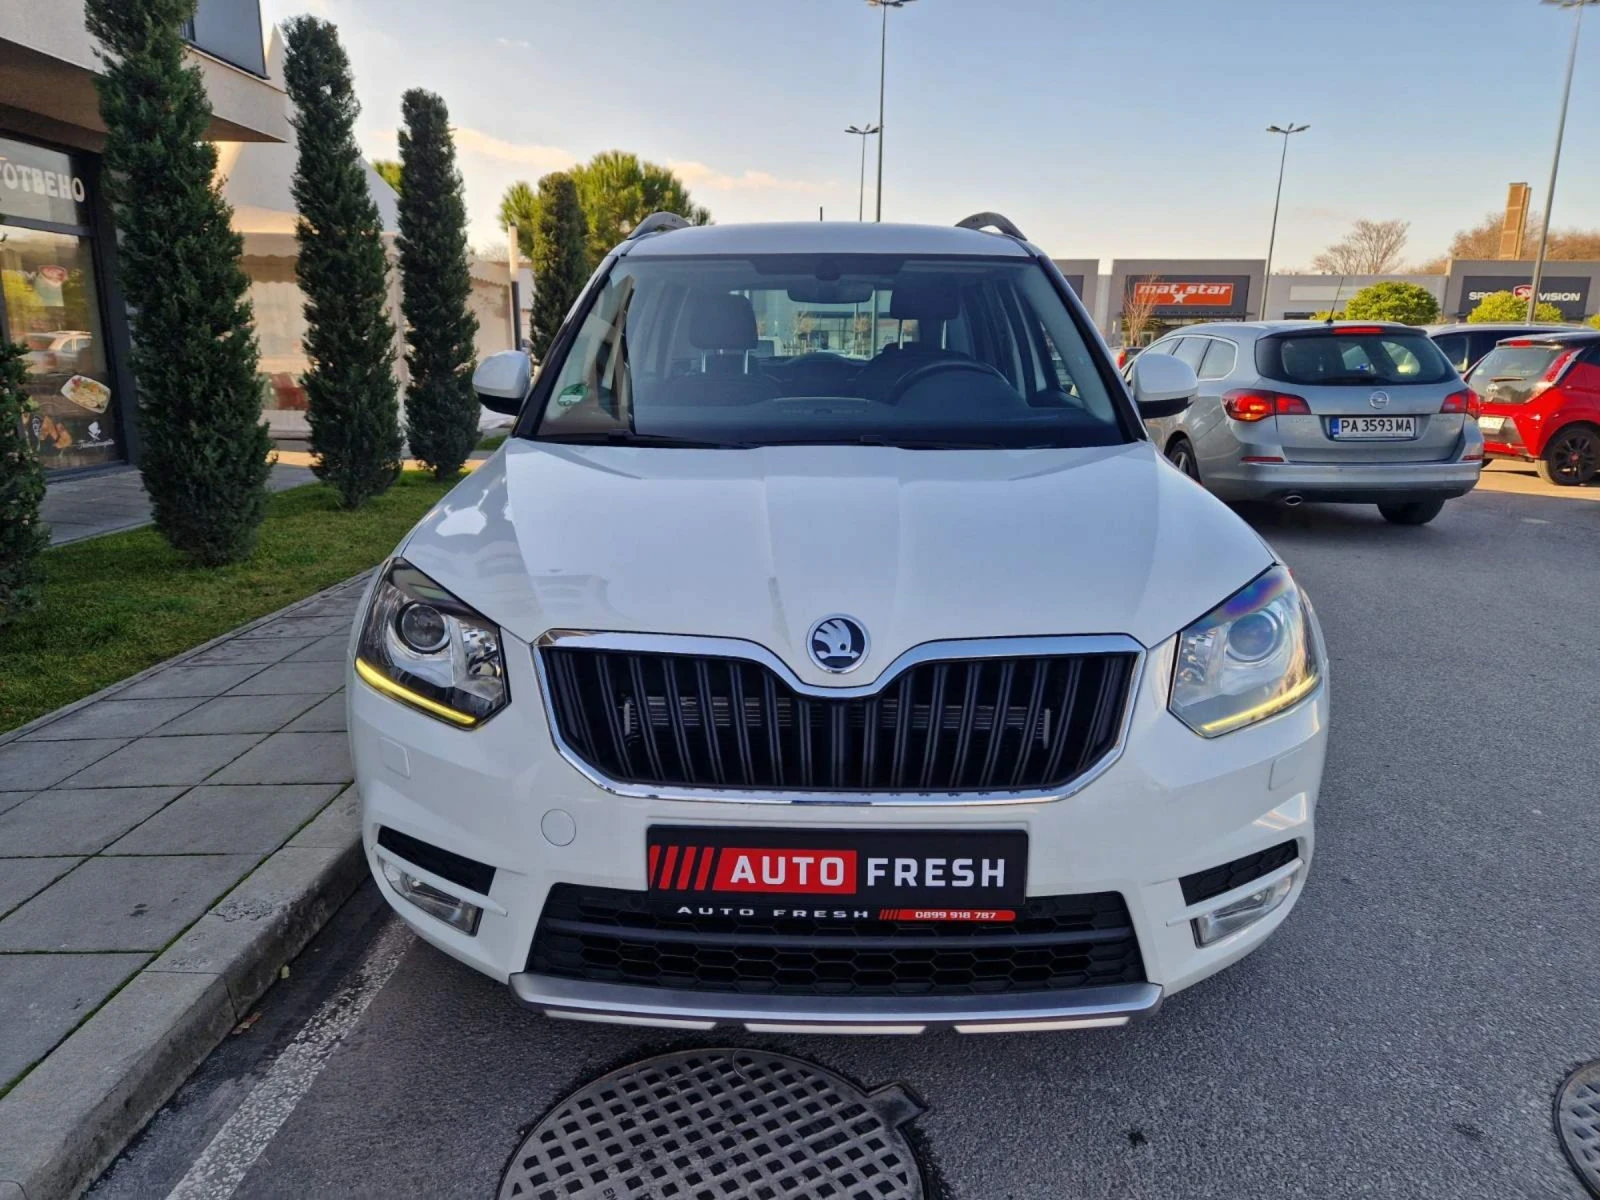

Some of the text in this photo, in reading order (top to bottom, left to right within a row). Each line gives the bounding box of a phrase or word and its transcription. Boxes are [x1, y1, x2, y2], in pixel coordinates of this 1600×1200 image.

[0, 162, 85, 203] ОТВЕНО
[1138, 283, 1231, 294] mat star
[1539, 292, 1581, 302] VISION
[1340, 418, 1412, 433] PA 3593 MA
[729, 855, 1006, 888] AUTO FRESH
[677, 906, 869, 919] AUTO FRESH
[914, 910, 997, 920] 0899 918 787
